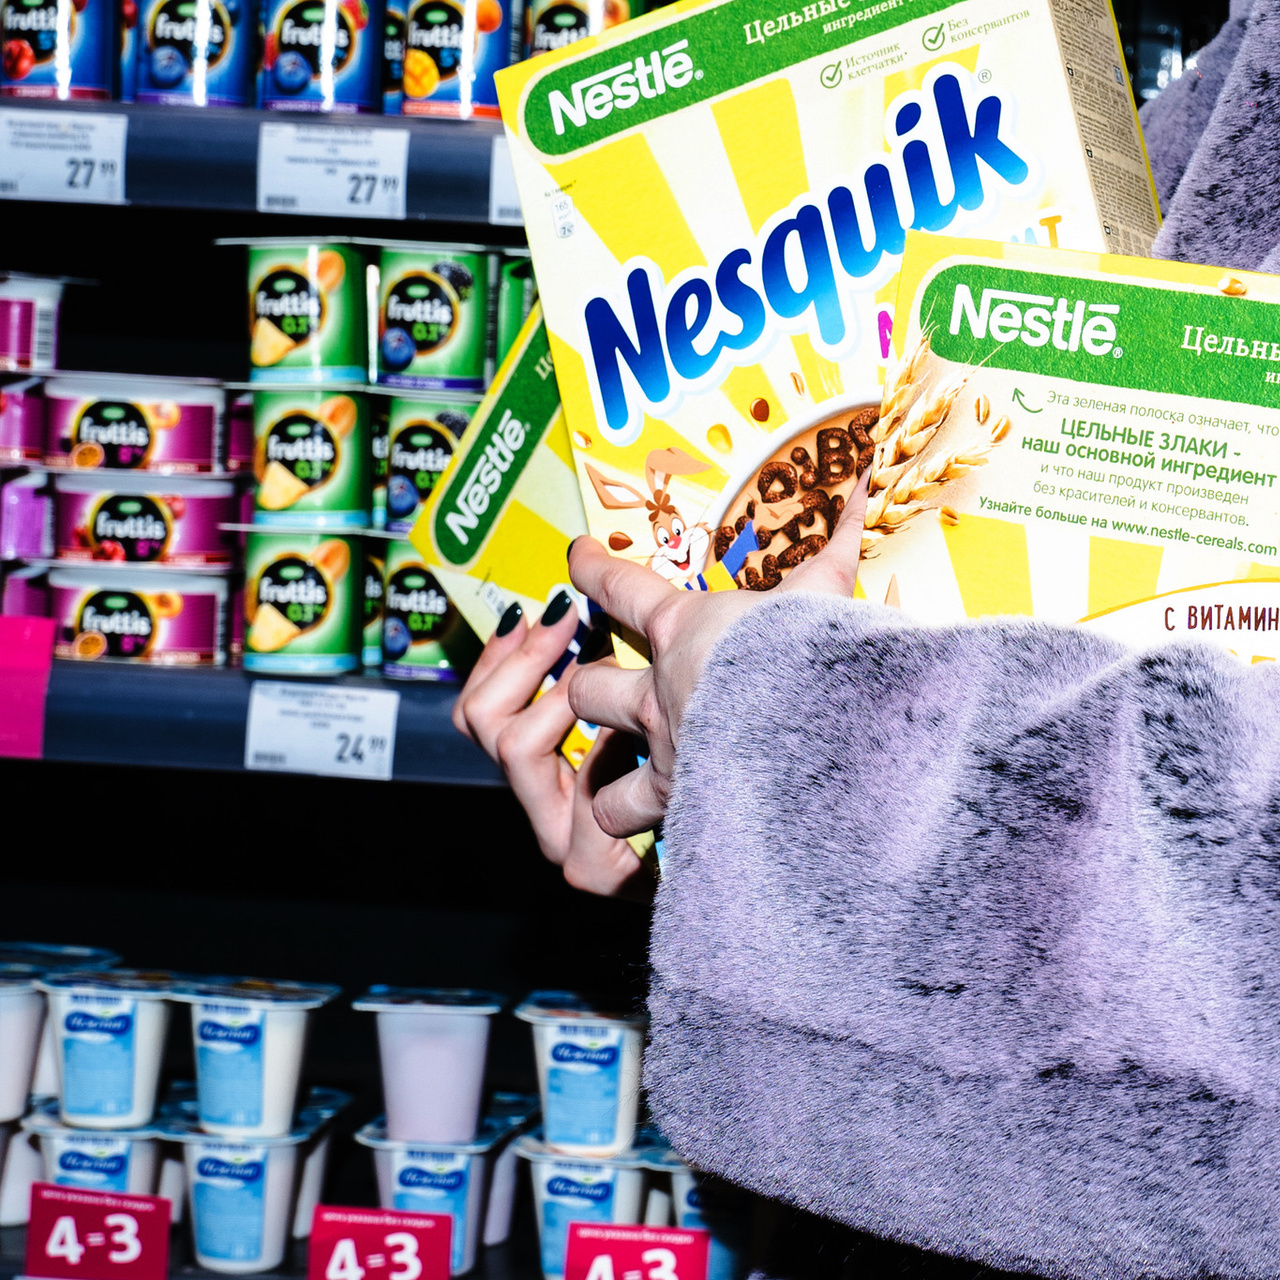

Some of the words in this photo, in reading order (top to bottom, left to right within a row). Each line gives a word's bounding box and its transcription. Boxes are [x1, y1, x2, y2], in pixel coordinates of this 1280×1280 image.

[948, 17, 970, 33] Без
[950, 9, 1031, 45] консервантов
[844, 42, 901, 70] Источник
[548, 39, 694, 136] Nestlé
[67, 159, 96, 189] 27
[347, 174, 377, 205] 27
[584, 73, 1029, 430] Nesquik
[256, 290, 322, 317] fruttis
[387, 294, 453, 326] fruttis
[950, 283, 1120, 356] Nestlé
[1047, 390, 1070, 406] Эта
[1073, 397, 1127, 415] зеленая
[1130, 405, 1184, 423] полоска
[1188, 413, 1252, 435] означает,
[1257, 423, 1280, 437] что
[79, 417, 149, 446] fruttis
[1060, 417, 1155, 448] ЦЕЛЬНЫЕ
[1159, 431, 1229, 459] ЗЛАКИ
[266, 434, 335, 463] fruttis
[1021, 436, 1060, 455] наш
[1065, 443, 1156, 470] основной
[1161, 458, 1279, 488] ингредиент
[1040, 463, 1049, 474] и
[1053, 464, 1075, 478] что
[1077, 468, 1105, 484] наш
[1108, 473, 1164, 493] продукт
[1167, 481, 1249, 506] произведен
[1033, 480, 1056, 496] без
[1059, 485, 1136, 509] красителей
[1139, 499, 1148, 510] и
[1151, 501, 1250, 527] консервантов.
[97, 513, 166, 541] fruttis
[979, 495, 1032, 517] Узнайте
[1035, 505, 1088, 526] больше
[1091, 516, 1109, 529] на
[1111, 520, 1278, 557] www.nestle-cereals.com
[258, 576, 328, 605] fruttis
[387, 584, 448, 615] fruttis
[82, 606, 152, 635] fruttis
[1164, 606, 1176, 632] С
[335, 733, 366, 764] 24
[46, 1213, 142, 1265] 4=3
